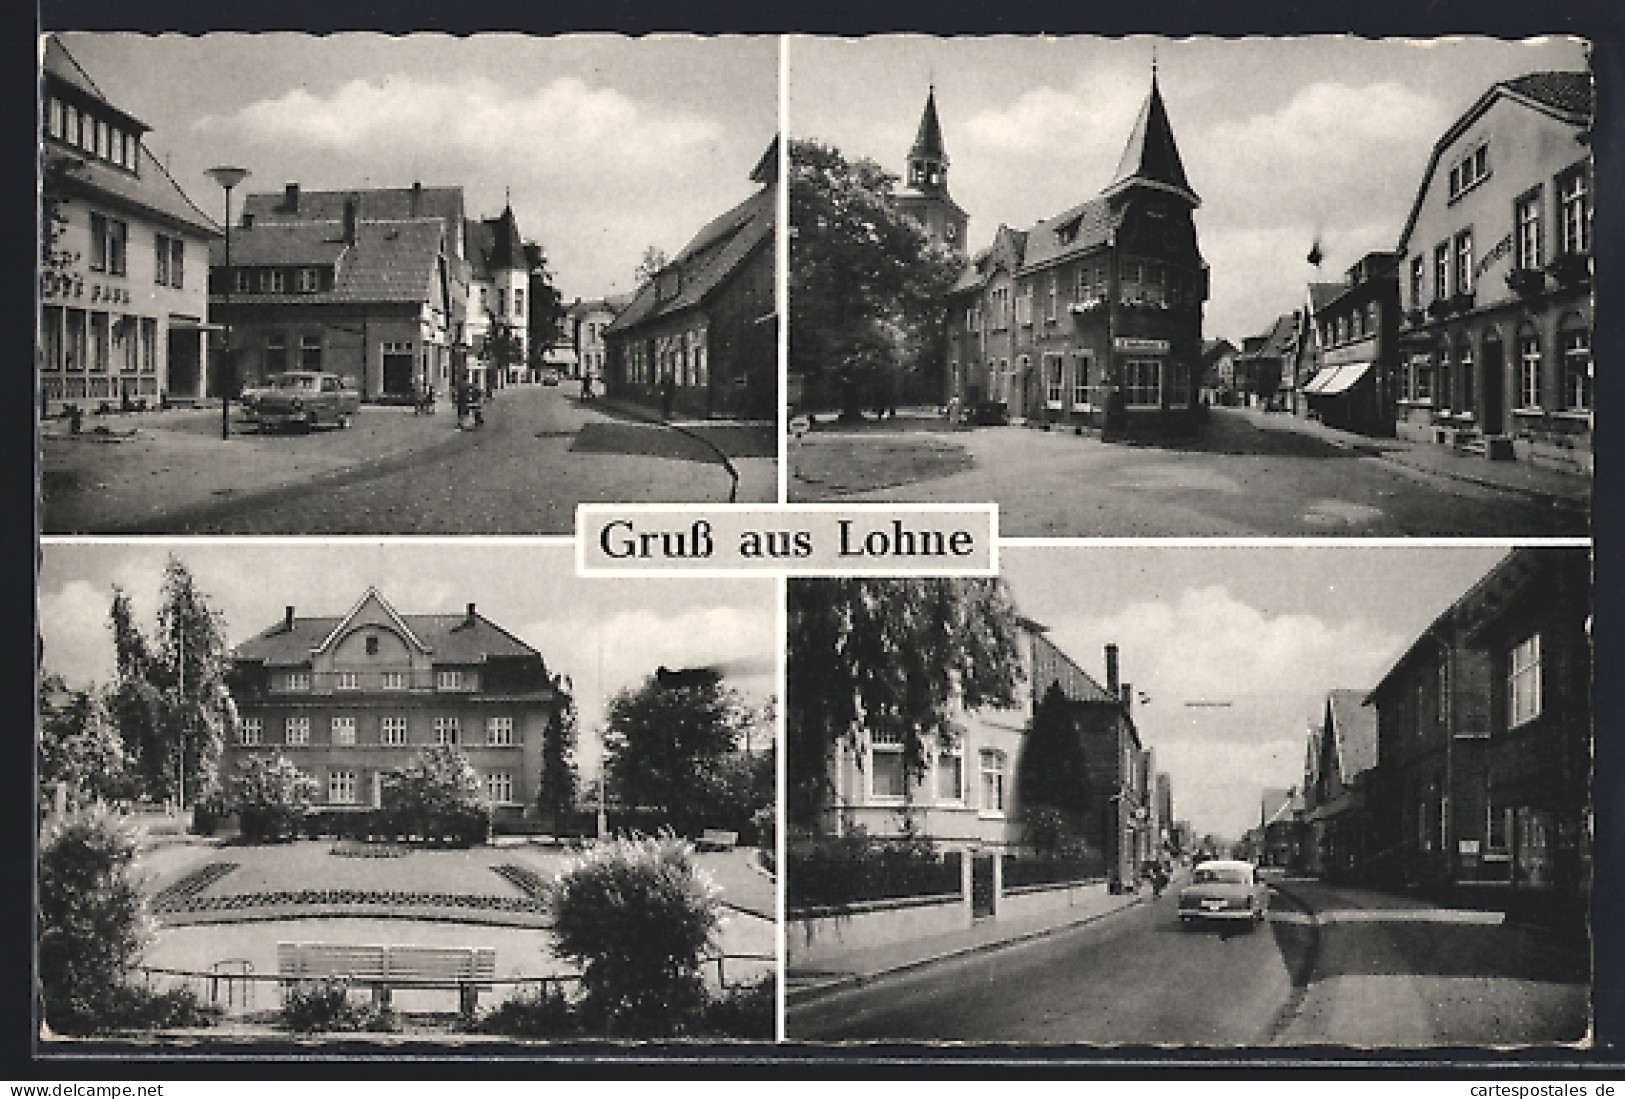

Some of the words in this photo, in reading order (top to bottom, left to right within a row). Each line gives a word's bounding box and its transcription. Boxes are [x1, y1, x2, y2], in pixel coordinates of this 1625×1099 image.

[600, 520, 713, 558] Gruß
[740, 531, 812, 558] aus
[837, 520, 974, 556] Lohne
